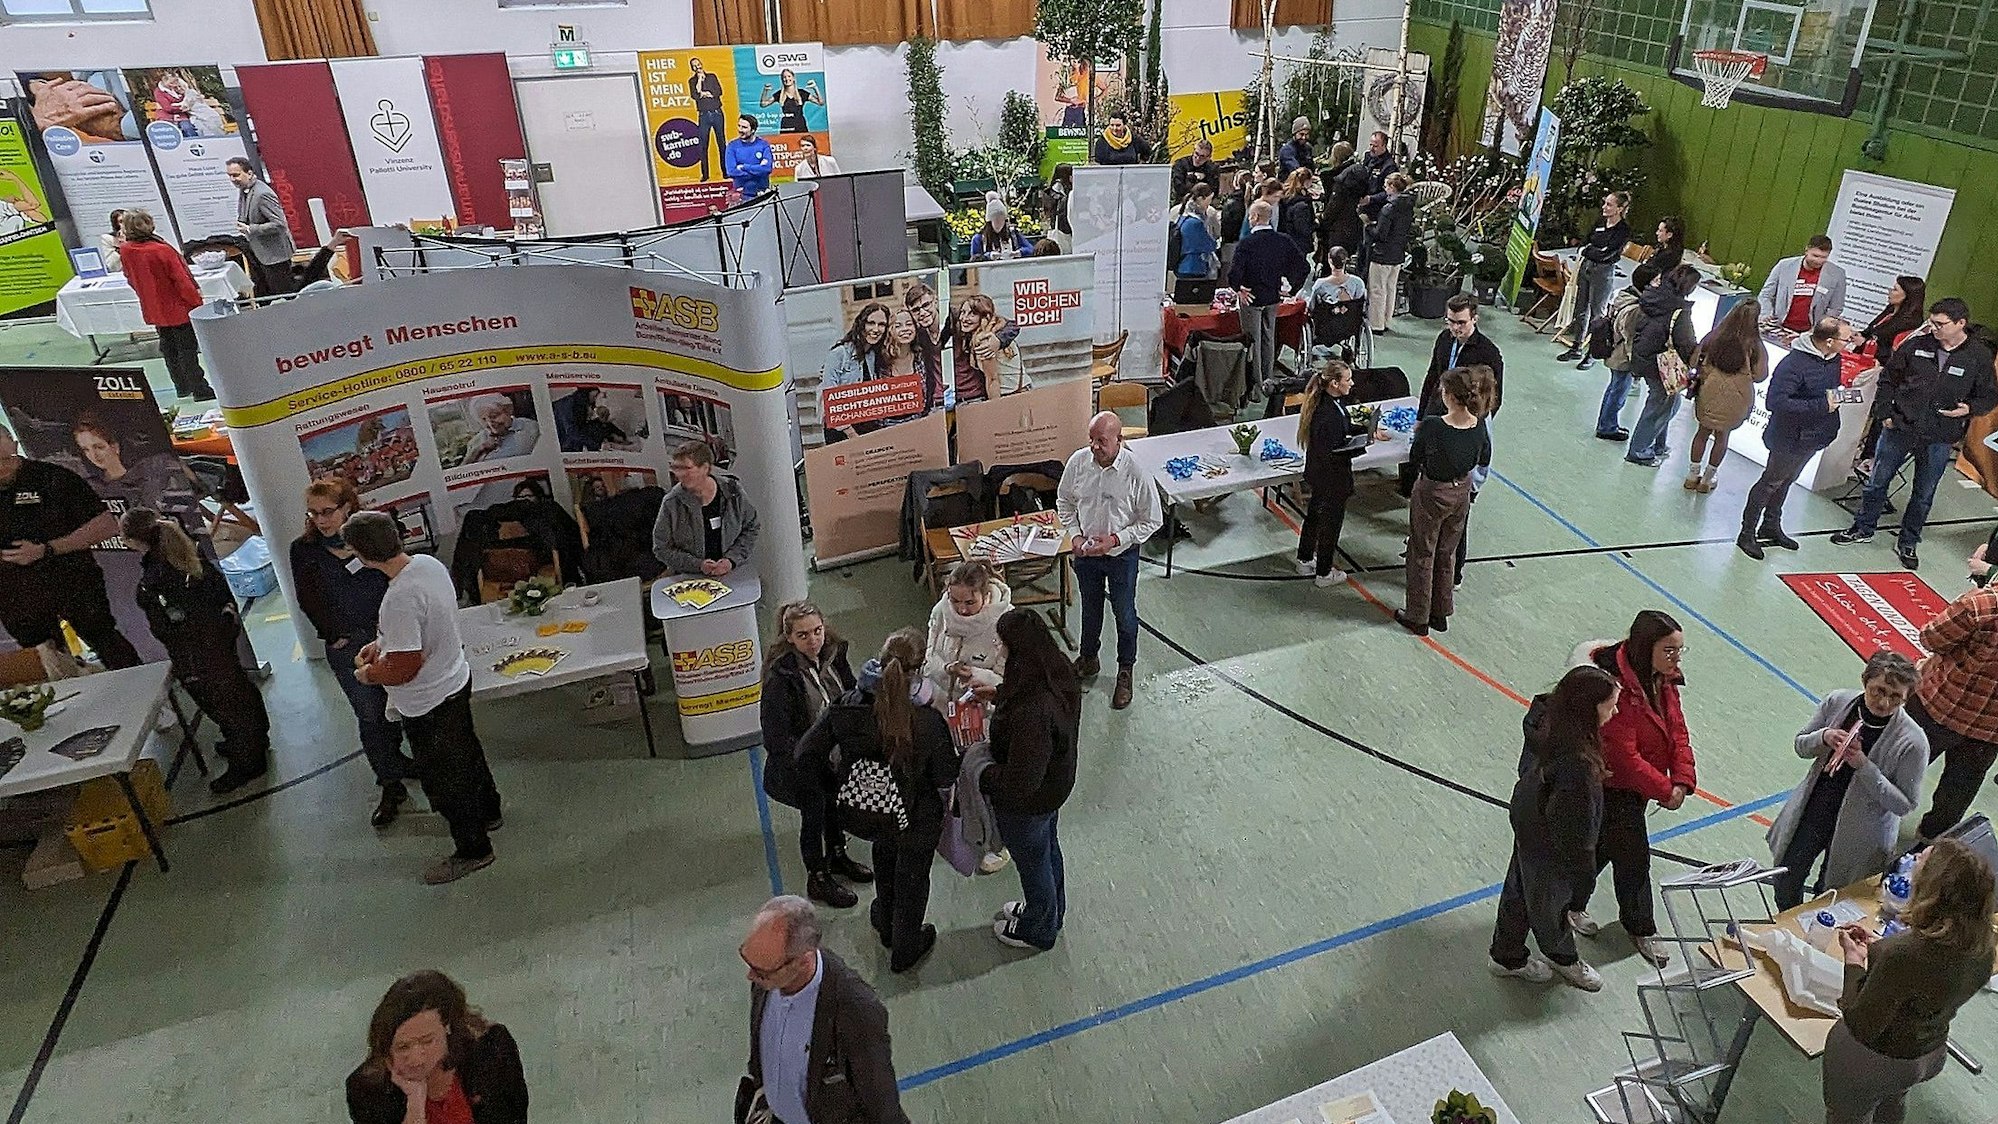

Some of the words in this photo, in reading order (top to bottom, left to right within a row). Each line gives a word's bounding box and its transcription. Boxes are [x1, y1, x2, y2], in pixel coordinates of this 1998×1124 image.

[559, 29, 575, 41] M
[646, 59, 676, 70] HIER
[777, 53, 808, 63] SWB
[648, 71, 667, 83] IST
[650, 83, 684, 96] MEIN
[652, 96, 691, 108] PLATZ
[1198, 92, 1245, 140] fuhs
[0, 125, 15, 136] O!
[660, 130, 683, 142] swb-
[662, 136, 700, 151] karriere
[770, 143, 788, 152] DEN
[667, 149, 682, 160] .de
[396, 164, 433, 173] University
[1868, 193, 1901, 205] Ausbildung
[1873, 201, 1896, 210] Studium
[1903, 214, 1921, 222] Arbeit
[1015, 281, 1048, 295] WIR
[1016, 293, 1079, 311] SUCHEN
[654, 293, 719, 332] ASB
[1017, 309, 1060, 326] DICH!
[276, 334, 374, 376] bewegt
[385, 315, 518, 345] Menschen
[93, 376, 142, 390] ZOLL
[288, 375, 392, 411] Service-Hotline:
[395, 365, 427, 380] 0800
[457, 358, 474, 368] 22
[478, 355, 498, 365] 110
[515, 351, 597, 362] www.a-s-b.eu
[422, 380, 476, 395] Hausnotruf
[828, 383, 889, 401] AUSBILDUNG
[829, 391, 919, 414] RECHTSANWALTS-
[295, 403, 371, 432] Rettungswesen
[830, 401, 919, 423] FACHANGESTELLTEN
[444, 465, 508, 483] Bildungswerk
[16, 491, 40, 500] ZOLL
[695, 639, 754, 670] ASB
